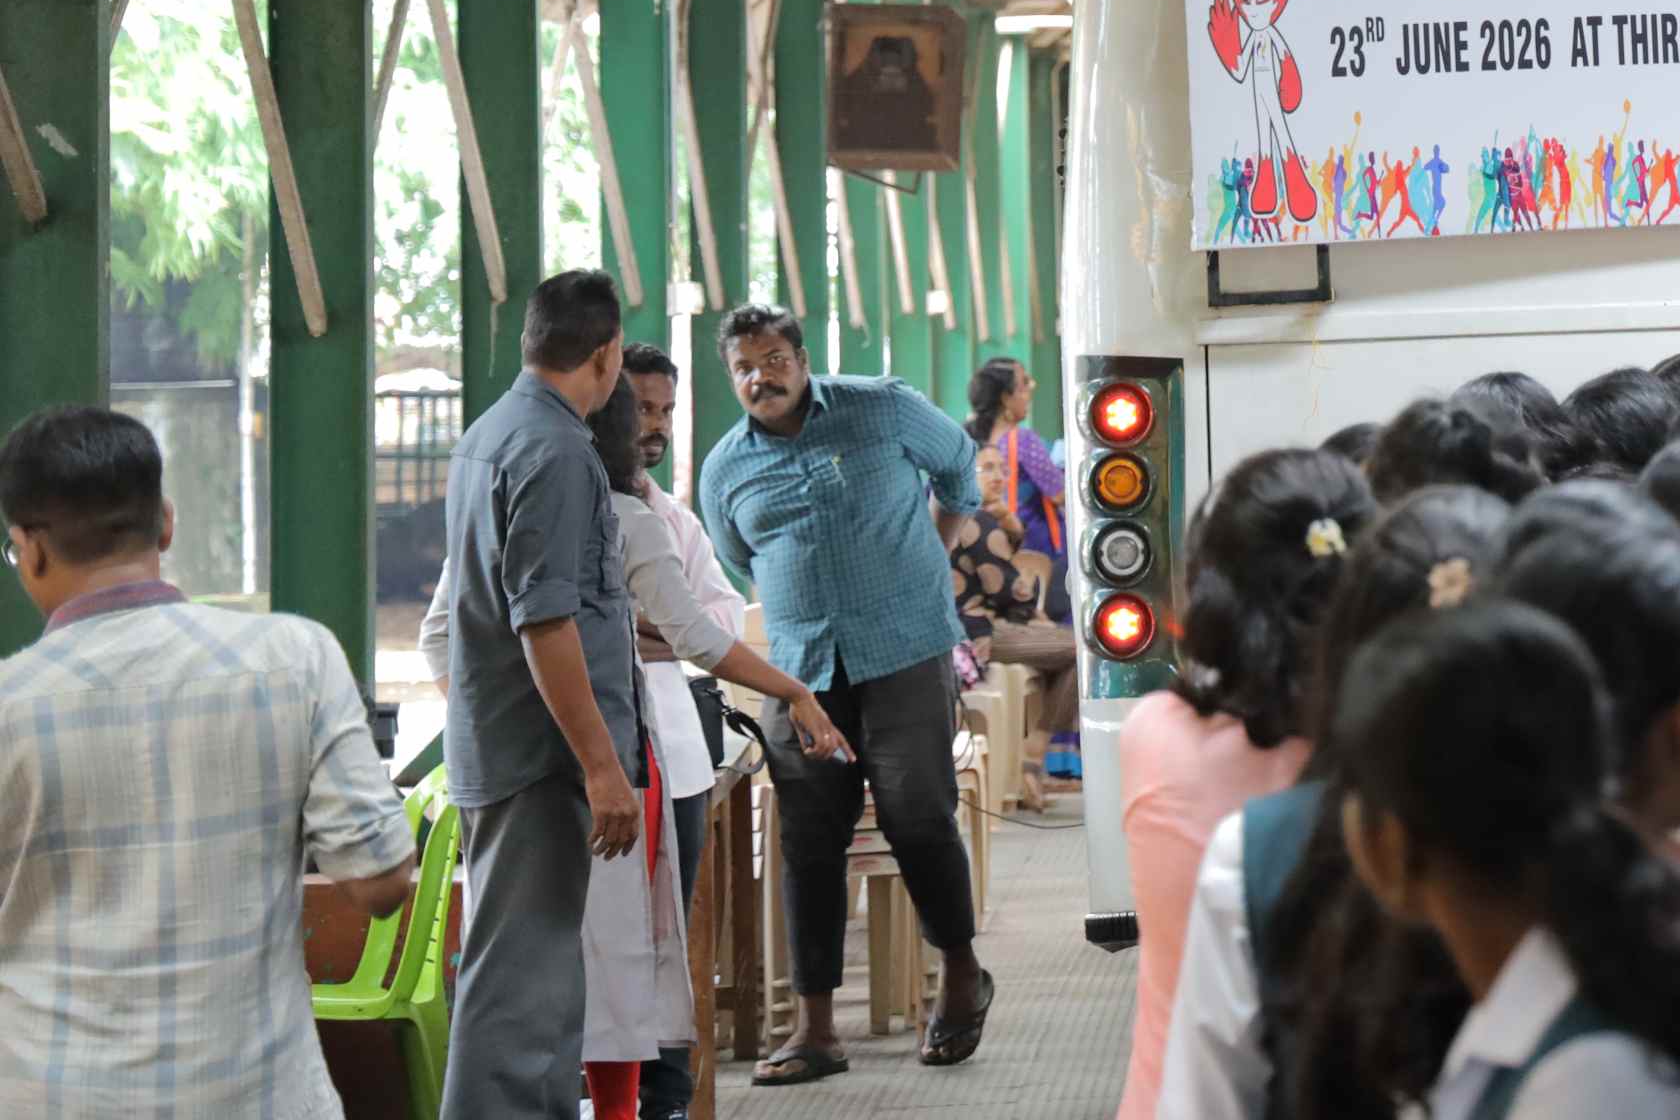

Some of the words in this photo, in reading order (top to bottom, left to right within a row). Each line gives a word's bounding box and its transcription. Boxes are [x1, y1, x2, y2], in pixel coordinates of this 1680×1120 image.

[1396, 21, 1470, 76] JUNE
[1479, 17, 1552, 71] 2026
[1571, 15, 1603, 68] AT
